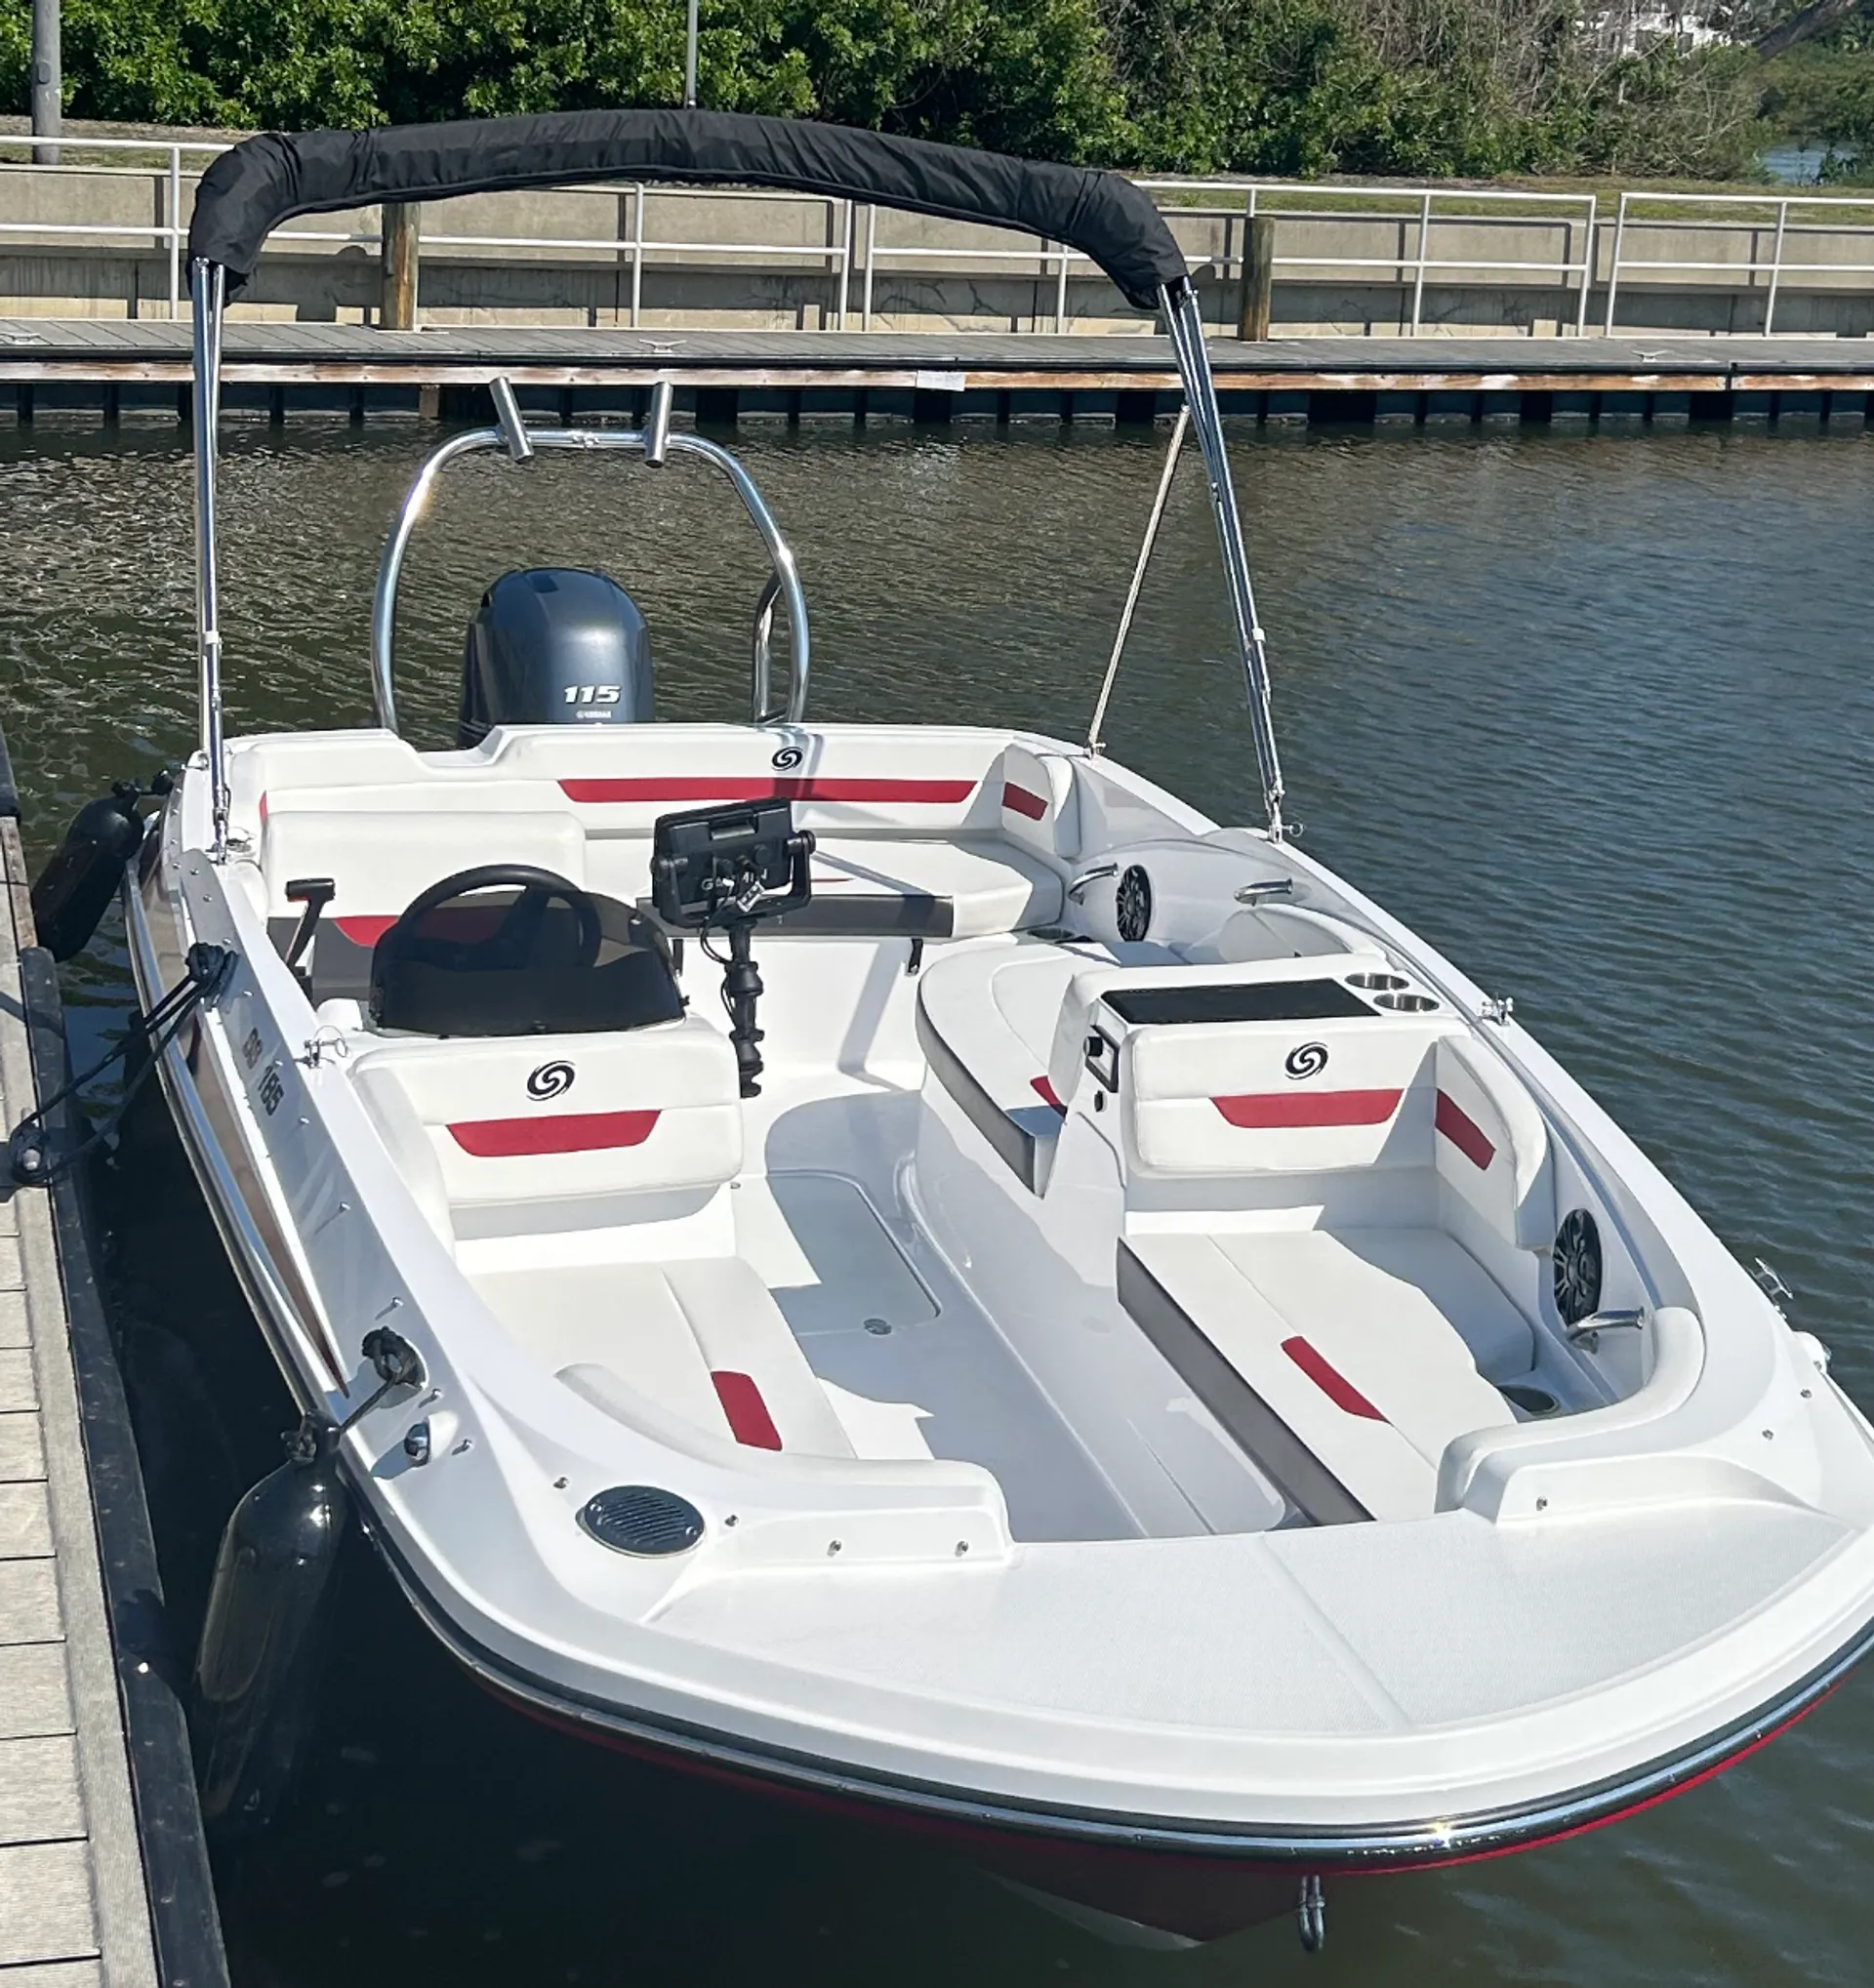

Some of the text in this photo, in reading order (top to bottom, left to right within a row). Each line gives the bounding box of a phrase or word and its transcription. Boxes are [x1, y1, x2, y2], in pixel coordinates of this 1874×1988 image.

[563, 685, 622, 704] 115
[702, 869, 767, 890] GAMI
[258, 1065, 284, 1116] 185
